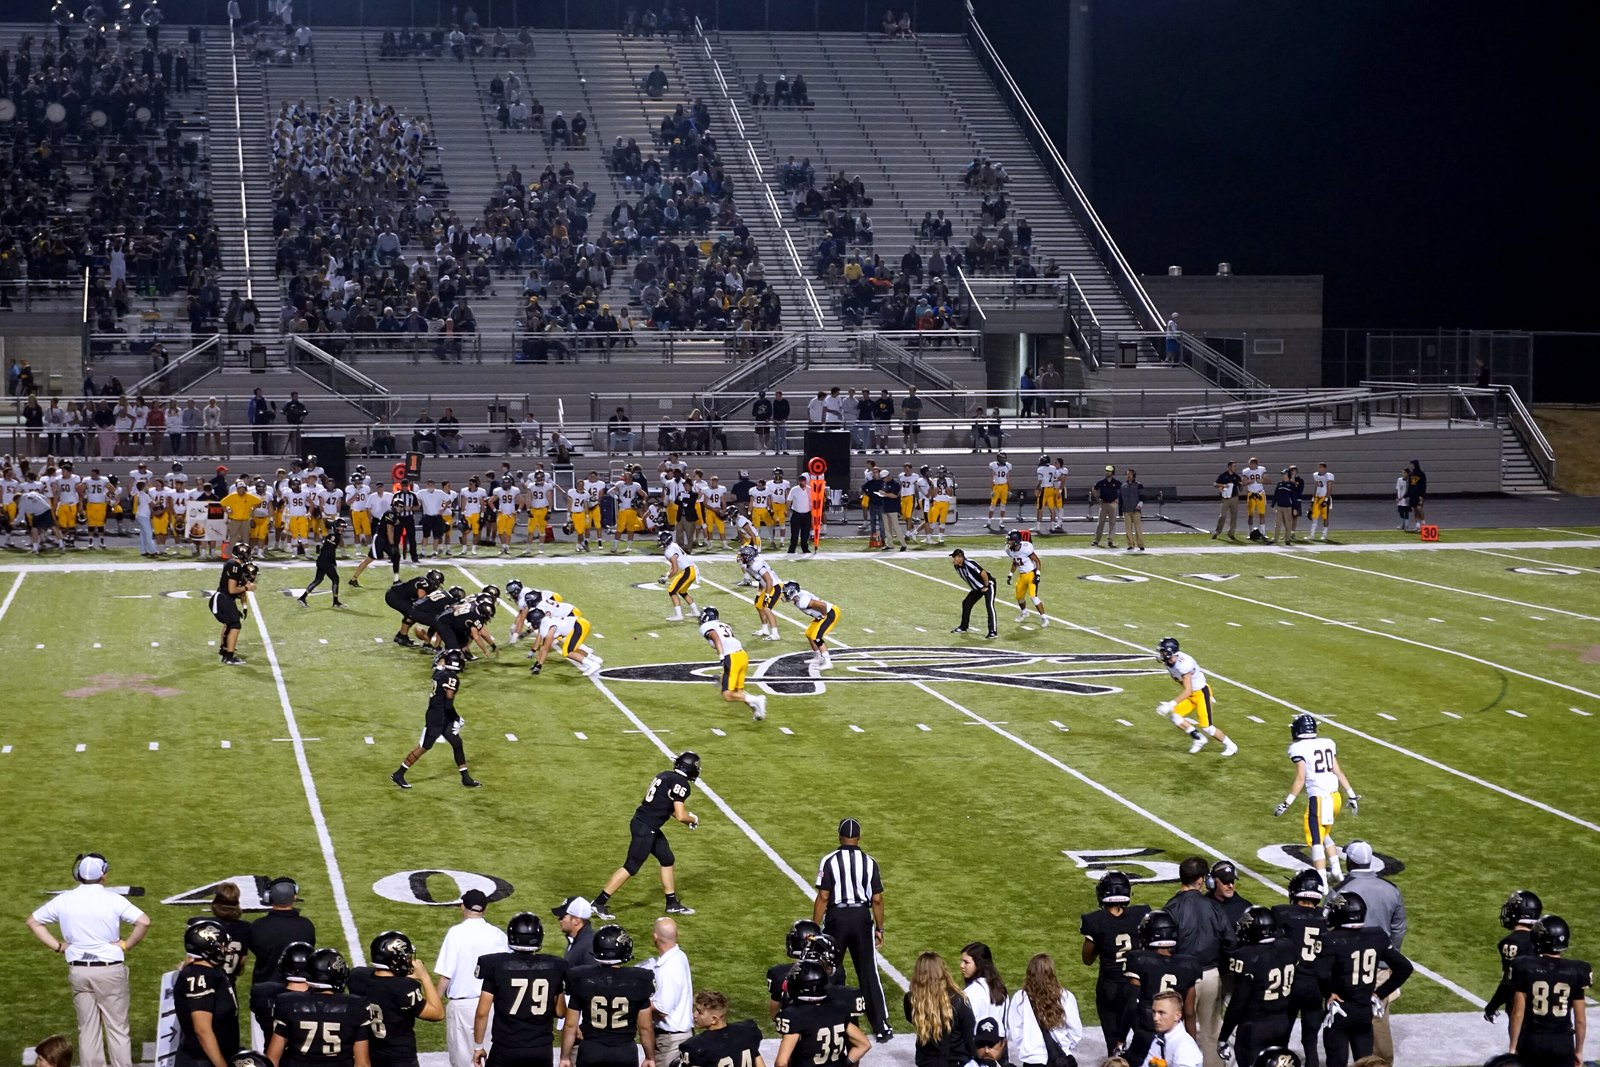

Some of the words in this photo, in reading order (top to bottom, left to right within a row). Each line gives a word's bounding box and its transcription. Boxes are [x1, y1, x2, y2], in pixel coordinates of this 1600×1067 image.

[410, 455, 417, 470] 1
[1423, 528, 1437, 538] 30
[448, 677, 457, 687] 13
[1314, 748, 1334, 773] 20
[672, 783, 687, 797] 86
[1115, 933, 1132, 963] 2
[1502, 943, 1518, 957] 48
[1229, 958, 1244, 973] 20
[1351, 948, 1377, 986] 19
[186, 975, 206, 992] 74
[1263, 963, 1295, 1001] 20
[407, 988, 422, 1007] 78
[509, 978, 549, 1016] 79
[1532, 980, 1571, 1017] 83
[590, 996, 629, 1029] 62
[775, 1017, 790, 1033] 35
[300, 1021, 341, 1056] 75
[813, 1023, 845, 1065] 35
